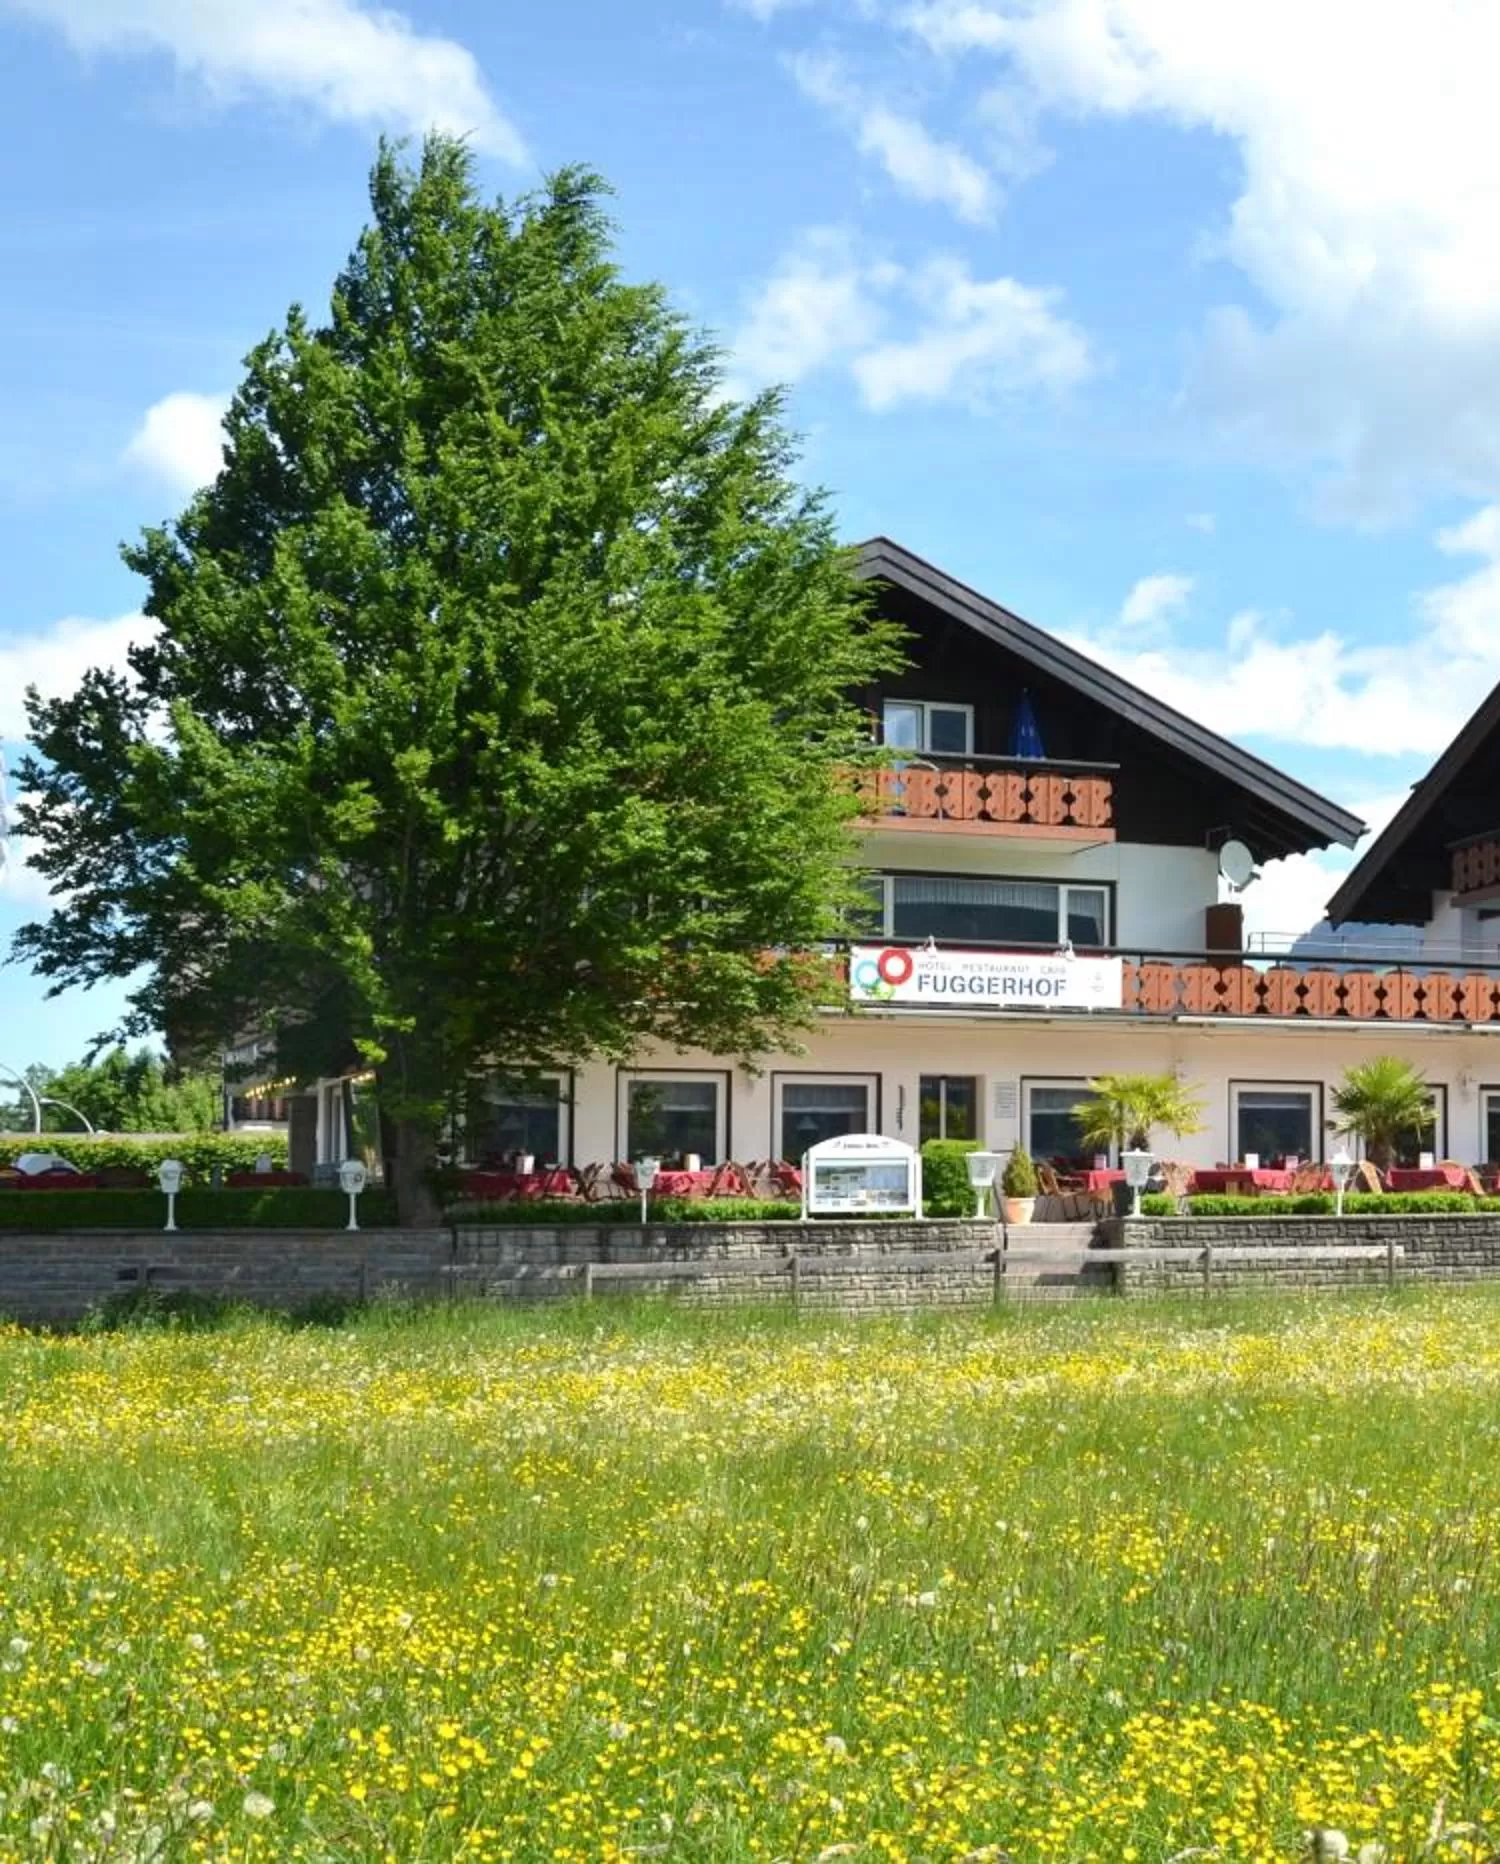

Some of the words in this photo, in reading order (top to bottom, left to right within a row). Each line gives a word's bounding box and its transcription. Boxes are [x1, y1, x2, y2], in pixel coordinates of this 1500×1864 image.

[918, 961, 951, 971] HOTEL
[961, 963, 1030, 973] RESTAURANT
[917, 973, 1067, 997] FUGGERHOF
